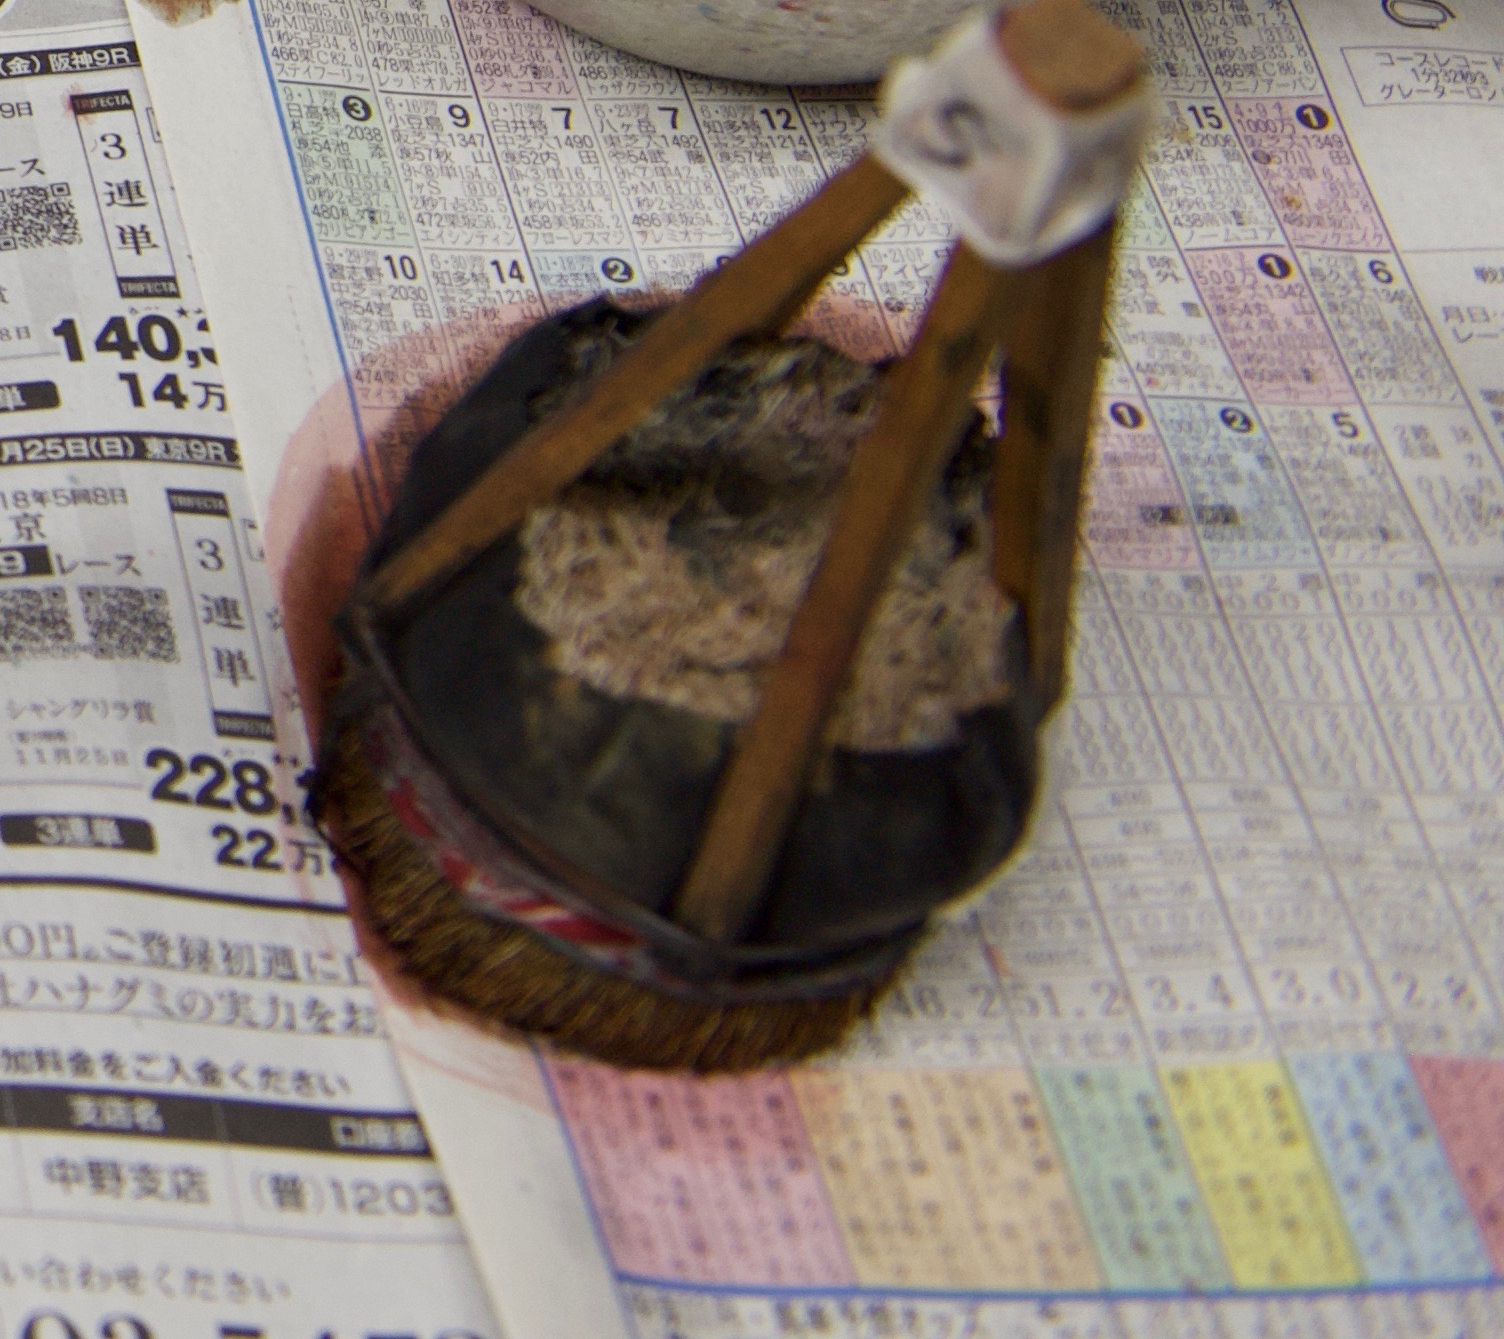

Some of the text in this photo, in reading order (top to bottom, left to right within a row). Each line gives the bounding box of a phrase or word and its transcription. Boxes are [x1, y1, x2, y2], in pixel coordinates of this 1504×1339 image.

[49, 46, 132, 75] 阪神9R
[54, 550, 143, 579] レース
